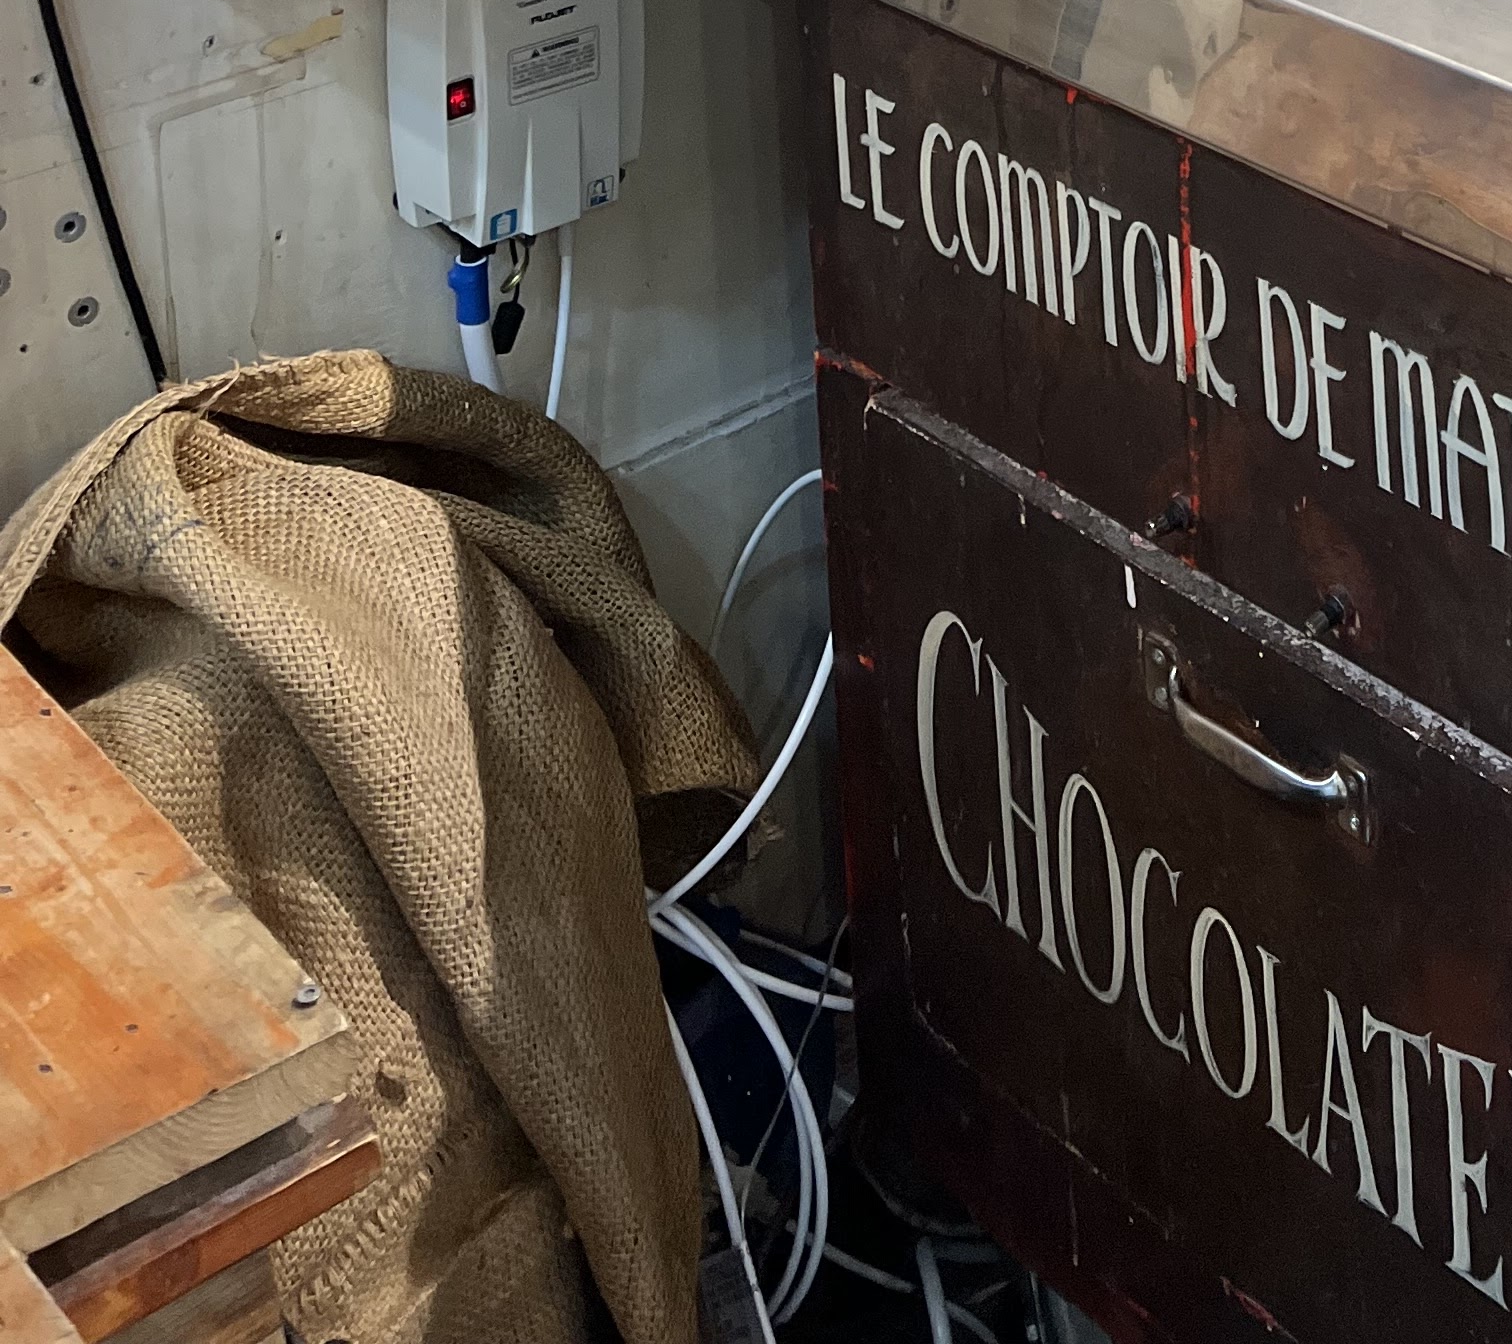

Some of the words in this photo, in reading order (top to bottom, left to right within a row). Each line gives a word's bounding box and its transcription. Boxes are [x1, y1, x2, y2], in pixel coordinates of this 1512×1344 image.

[832, 72, 905, 231] LE
[920, 121, 1238, 408] COMPTOIR
[1255, 277, 1355, 470] DE
